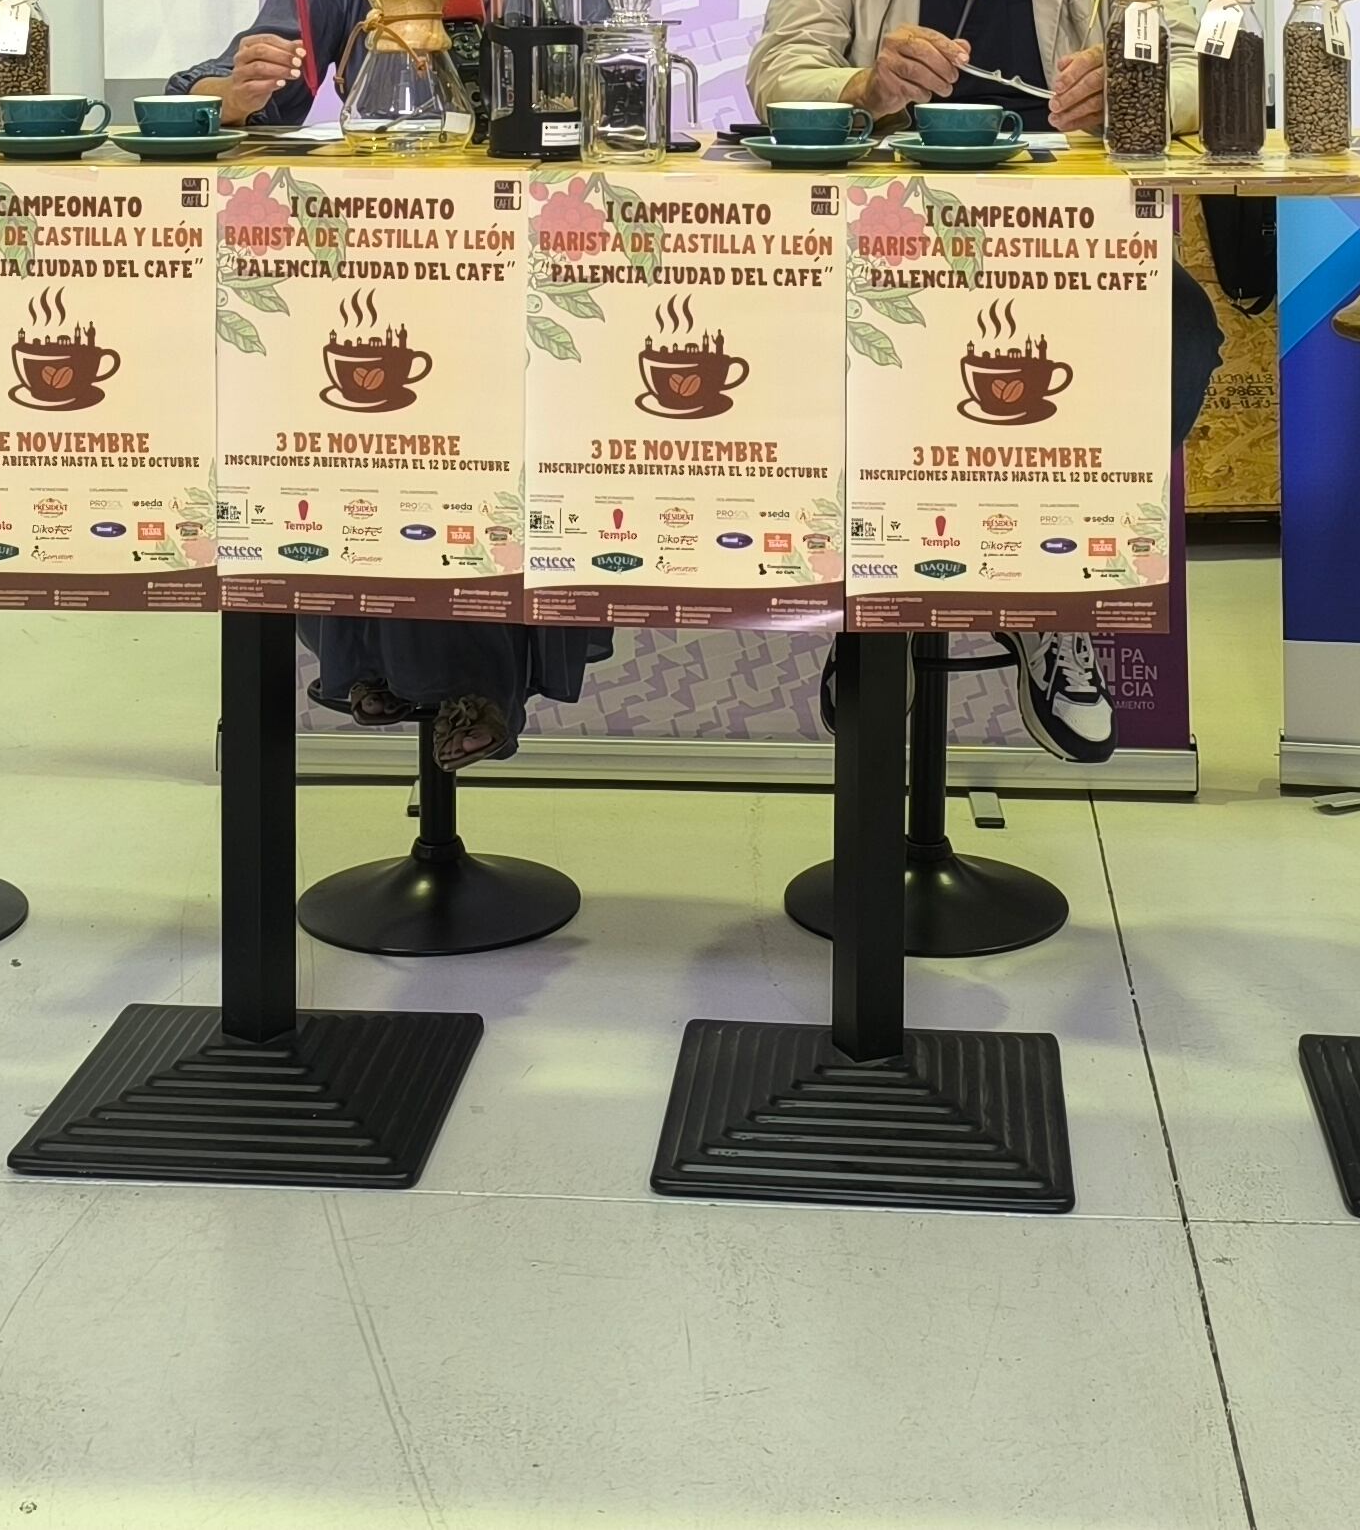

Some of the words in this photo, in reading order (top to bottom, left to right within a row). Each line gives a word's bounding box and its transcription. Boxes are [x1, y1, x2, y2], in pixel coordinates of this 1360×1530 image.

[291, 197, 299, 217] I
[305, 197, 454, 219] CAMPEONATO
[926, 206, 935, 227] I
[941, 206, 1094, 228] CAMPEONATO
[5, 226, 27, 245] DE
[34, 227, 127, 246] CASTILLA
[134, 227, 145, 246] Y
[152, 221, 202, 247] LEÓN
[225, 226, 309, 246] BARISTA
[316, 228, 338, 247] DE
[345, 229, 439, 248] CASTILLA
[446, 230, 457, 249] Y
[464, 223, 514, 250] LEÓN
[859, 236, 945, 256] BARISTA
[952, 237, 975, 257] DE
[982, 238, 1076, 258] CASTILLA
[1086, 239, 1098, 258] Y
[1106, 232, 1157, 259] LEÓN
[26, 260, 97, 278] CIUDAD
[103, 260, 139, 278] DEL
[337, 261, 409, 279] CIUDAD
[414, 262, 450, 280] DEL
[975, 271, 1048, 289] CIUDAD
[1054, 272, 1091, 290] DEL
[16, 432, 149, 453] NOVIEMBRE
[277, 432, 287, 452] 3
[294, 432, 321, 452] DE
[328, 433, 460, 455] NOVIEMBRE
[3, 455, 58, 467] ABIERTAS
[61, 456, 98, 467] HASTA
[101, 456, 114, 468] EL
[118, 456, 128, 468] 12
[131, 456, 145, 468] DE
[149, 457, 199, 468] OCTUBRE
[913, 446, 924, 466] 3
[931, 446, 958, 466] DE
[966, 446, 1102, 468] NOVIEMBRE
[1121, 648, 1144, 663] PA
[1122, 665, 1157, 680] LEN
[1122, 682, 1154, 696] CIA
